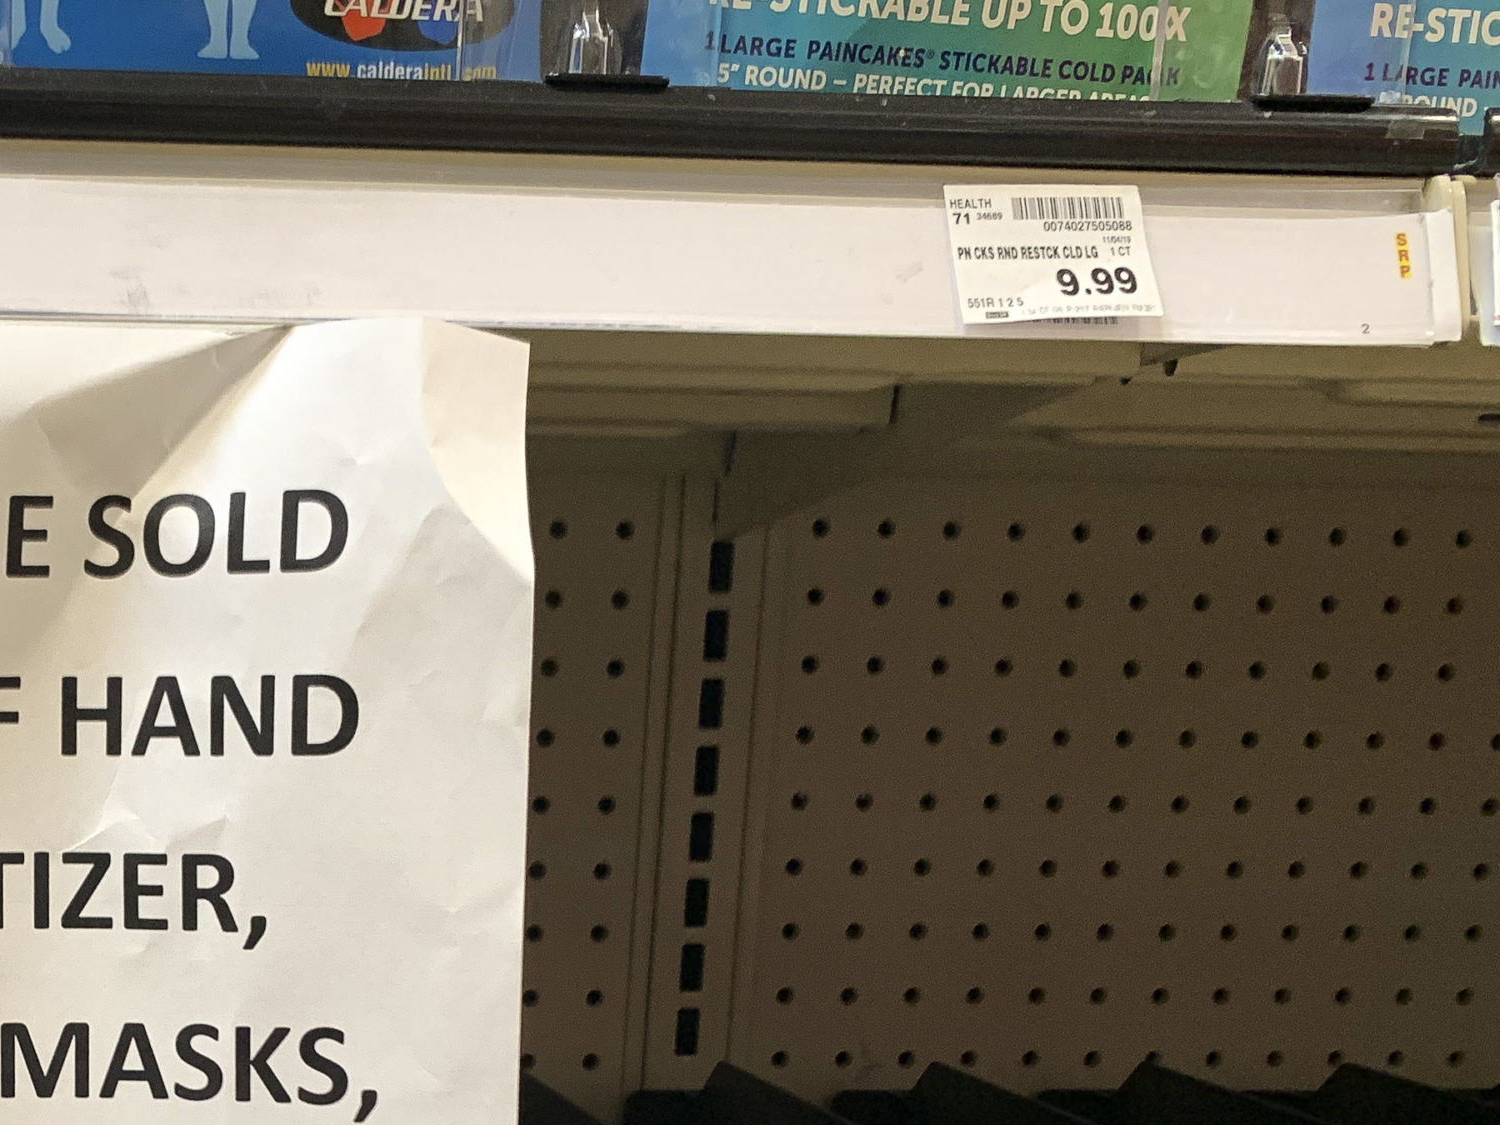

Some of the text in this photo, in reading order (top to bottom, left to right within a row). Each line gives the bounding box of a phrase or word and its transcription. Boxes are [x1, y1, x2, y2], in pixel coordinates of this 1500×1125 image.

[324, 0, 484, 22] CALDERA
[982, 0, 1191, 41] UP TO 100X
[720, 34, 797, 58] LARGE
[940, 50, 1053, 78] STICKABLE
[1058, 60, 1115, 83] COLD
[744, 66, 826, 90] ROUND
[852, 73, 947, 96] PERFECT
[951, 80, 994, 97] FOR
[1364, 62, 1374, 81] 1
[950, 199, 992, 208] HEALTH
[953, 213, 970, 224] 71
[1044, 221, 1132, 231] 0074027505088
[958, 247, 971, 259] PN
[975, 247, 994, 259] CKS
[998, 247, 1018, 259] RND
[1021, 247, 1060, 259] RESTCK
[1063, 246, 1082, 258] CLD
[1085, 246, 1098, 258] LG
[1118, 247, 1130, 256] CT
[1057, 267, 1137, 295] 9.99
[968, 299, 994, 308] 551R
[1008, 298, 1014, 307] 2
[1361, 323, 1370, 334] 2
[83, 489, 350, 579] SOLD
[61, 674, 359, 757] HAND
[0, 1022, 378, 1123] MASKS,
